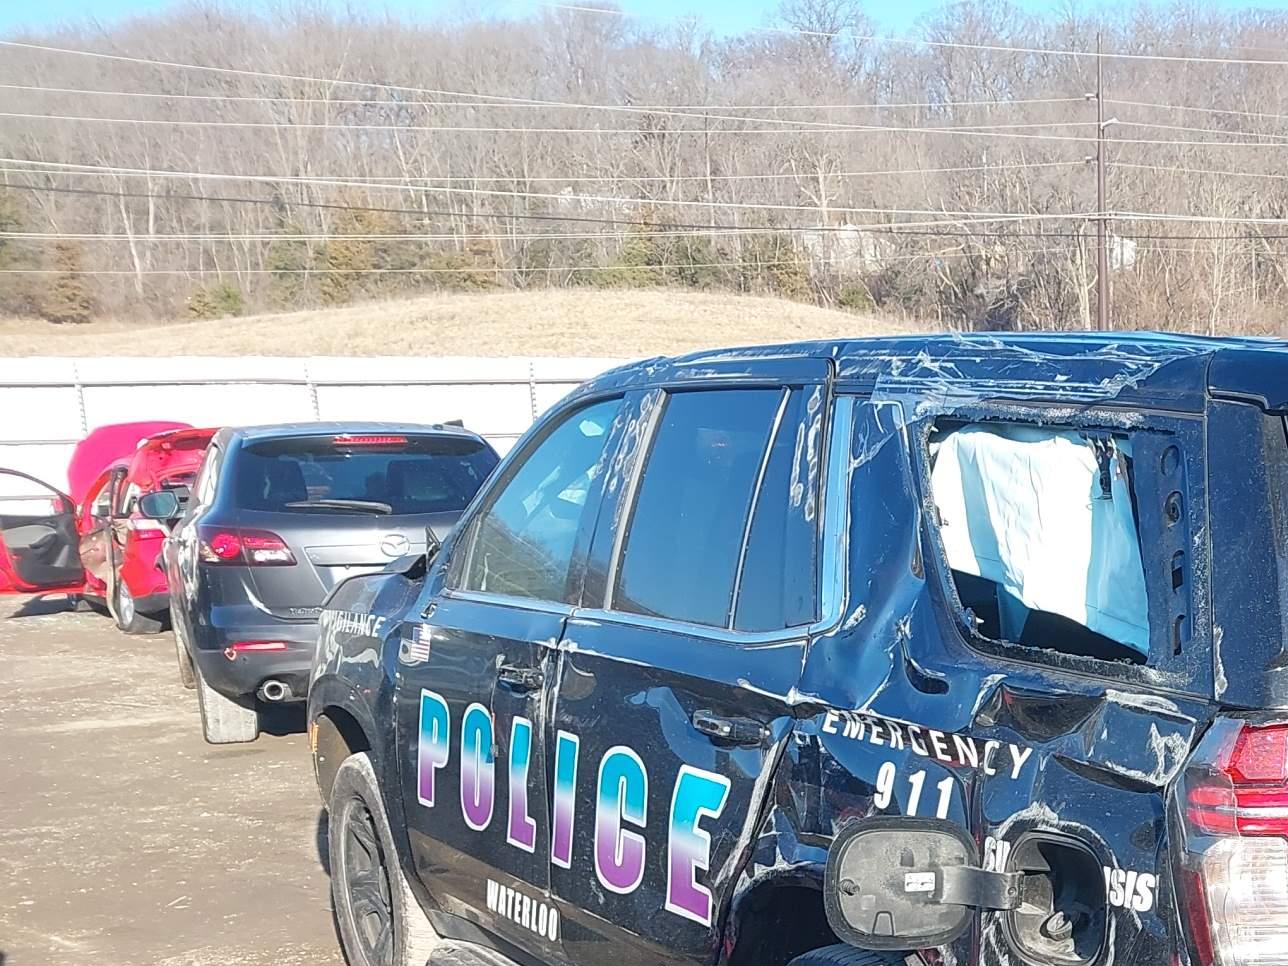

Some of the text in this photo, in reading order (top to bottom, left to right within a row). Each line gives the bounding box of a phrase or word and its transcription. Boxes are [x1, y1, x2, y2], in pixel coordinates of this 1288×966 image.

[821, 709, 1033, 780] EMERGENCY
[418, 688, 731, 928] POLICE
[486, 878, 558, 942] WATERLOO
